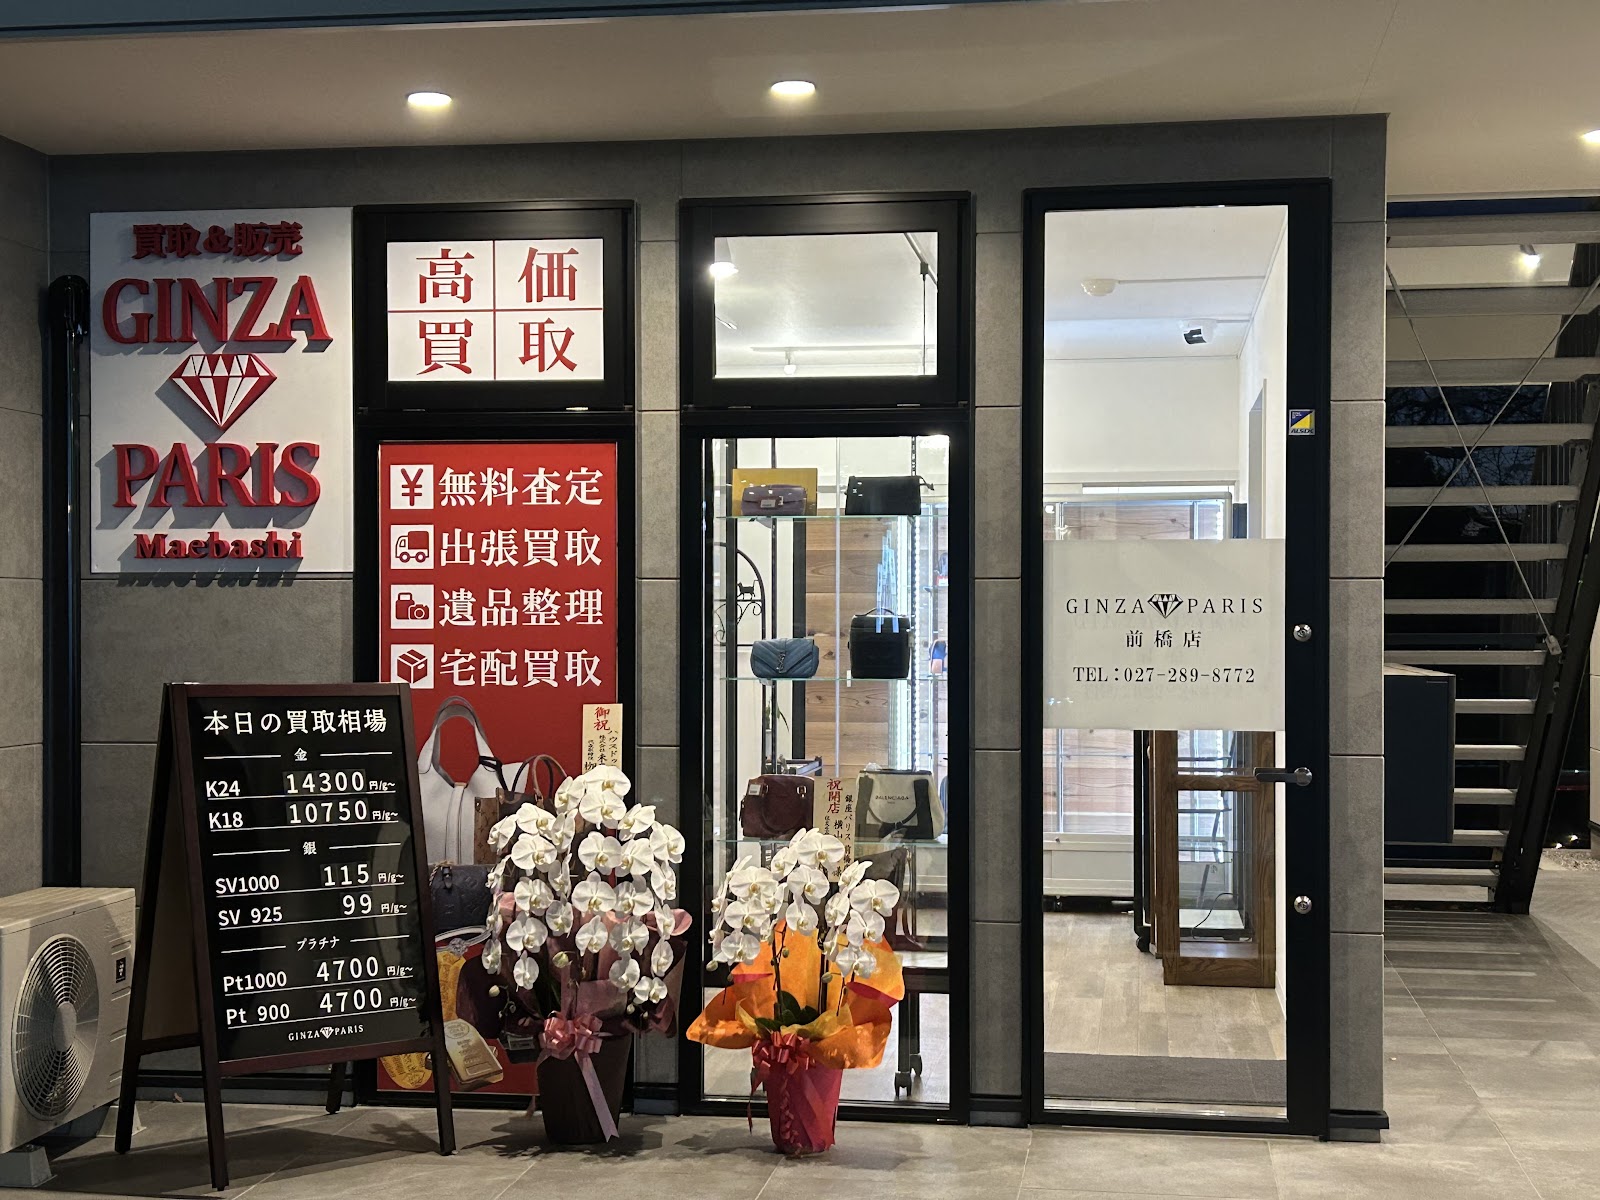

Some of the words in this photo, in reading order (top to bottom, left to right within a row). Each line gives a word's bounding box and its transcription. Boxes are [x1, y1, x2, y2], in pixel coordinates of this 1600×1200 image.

[132, 222, 303, 259] 買取&販売
[102, 275, 333, 343] GINZA
[112, 441, 321, 508] PARIS
[439, 467, 603, 507] 無料査定
[134, 531, 303, 559] Maebashi
[440, 528, 602, 567] 出張買取
[439, 587, 603, 627] 遺品整理
[1066, 598, 1145, 614] GINZA
[1187, 598, 1263, 614] PARIS
[1126, 630, 1202, 648] 前橋店
[440, 648, 602, 688] 宅配買取
[204, 709, 387, 735] 本日の買取相場
[294, 748, 308, 761] 金
[206, 780, 240, 798] K24
[286, 771, 365, 794] 14300
[827, 779, 843, 814] 祝開店
[209, 811, 243, 829] K18
[289, 800, 367, 824] 10750
[303, 841, 317, 855] 銀
[215, 875, 280, 894] SV1000
[323, 864, 369, 886] 115
[218, 910, 240, 927] SV
[251, 906, 283, 924] 925
[342, 894, 372, 915] 99
[297, 935, 340, 951] プラチナ
[223, 971, 287, 993] Pt1000
[317, 956, 379, 982] 4700
[226, 1008, 246, 1025] Pt
[257, 1004, 290, 1022] 900
[320, 987, 382, 1014] 4700
[288, 1029, 320, 1041] GINZA
[334, 1024, 364, 1036] PARIS
